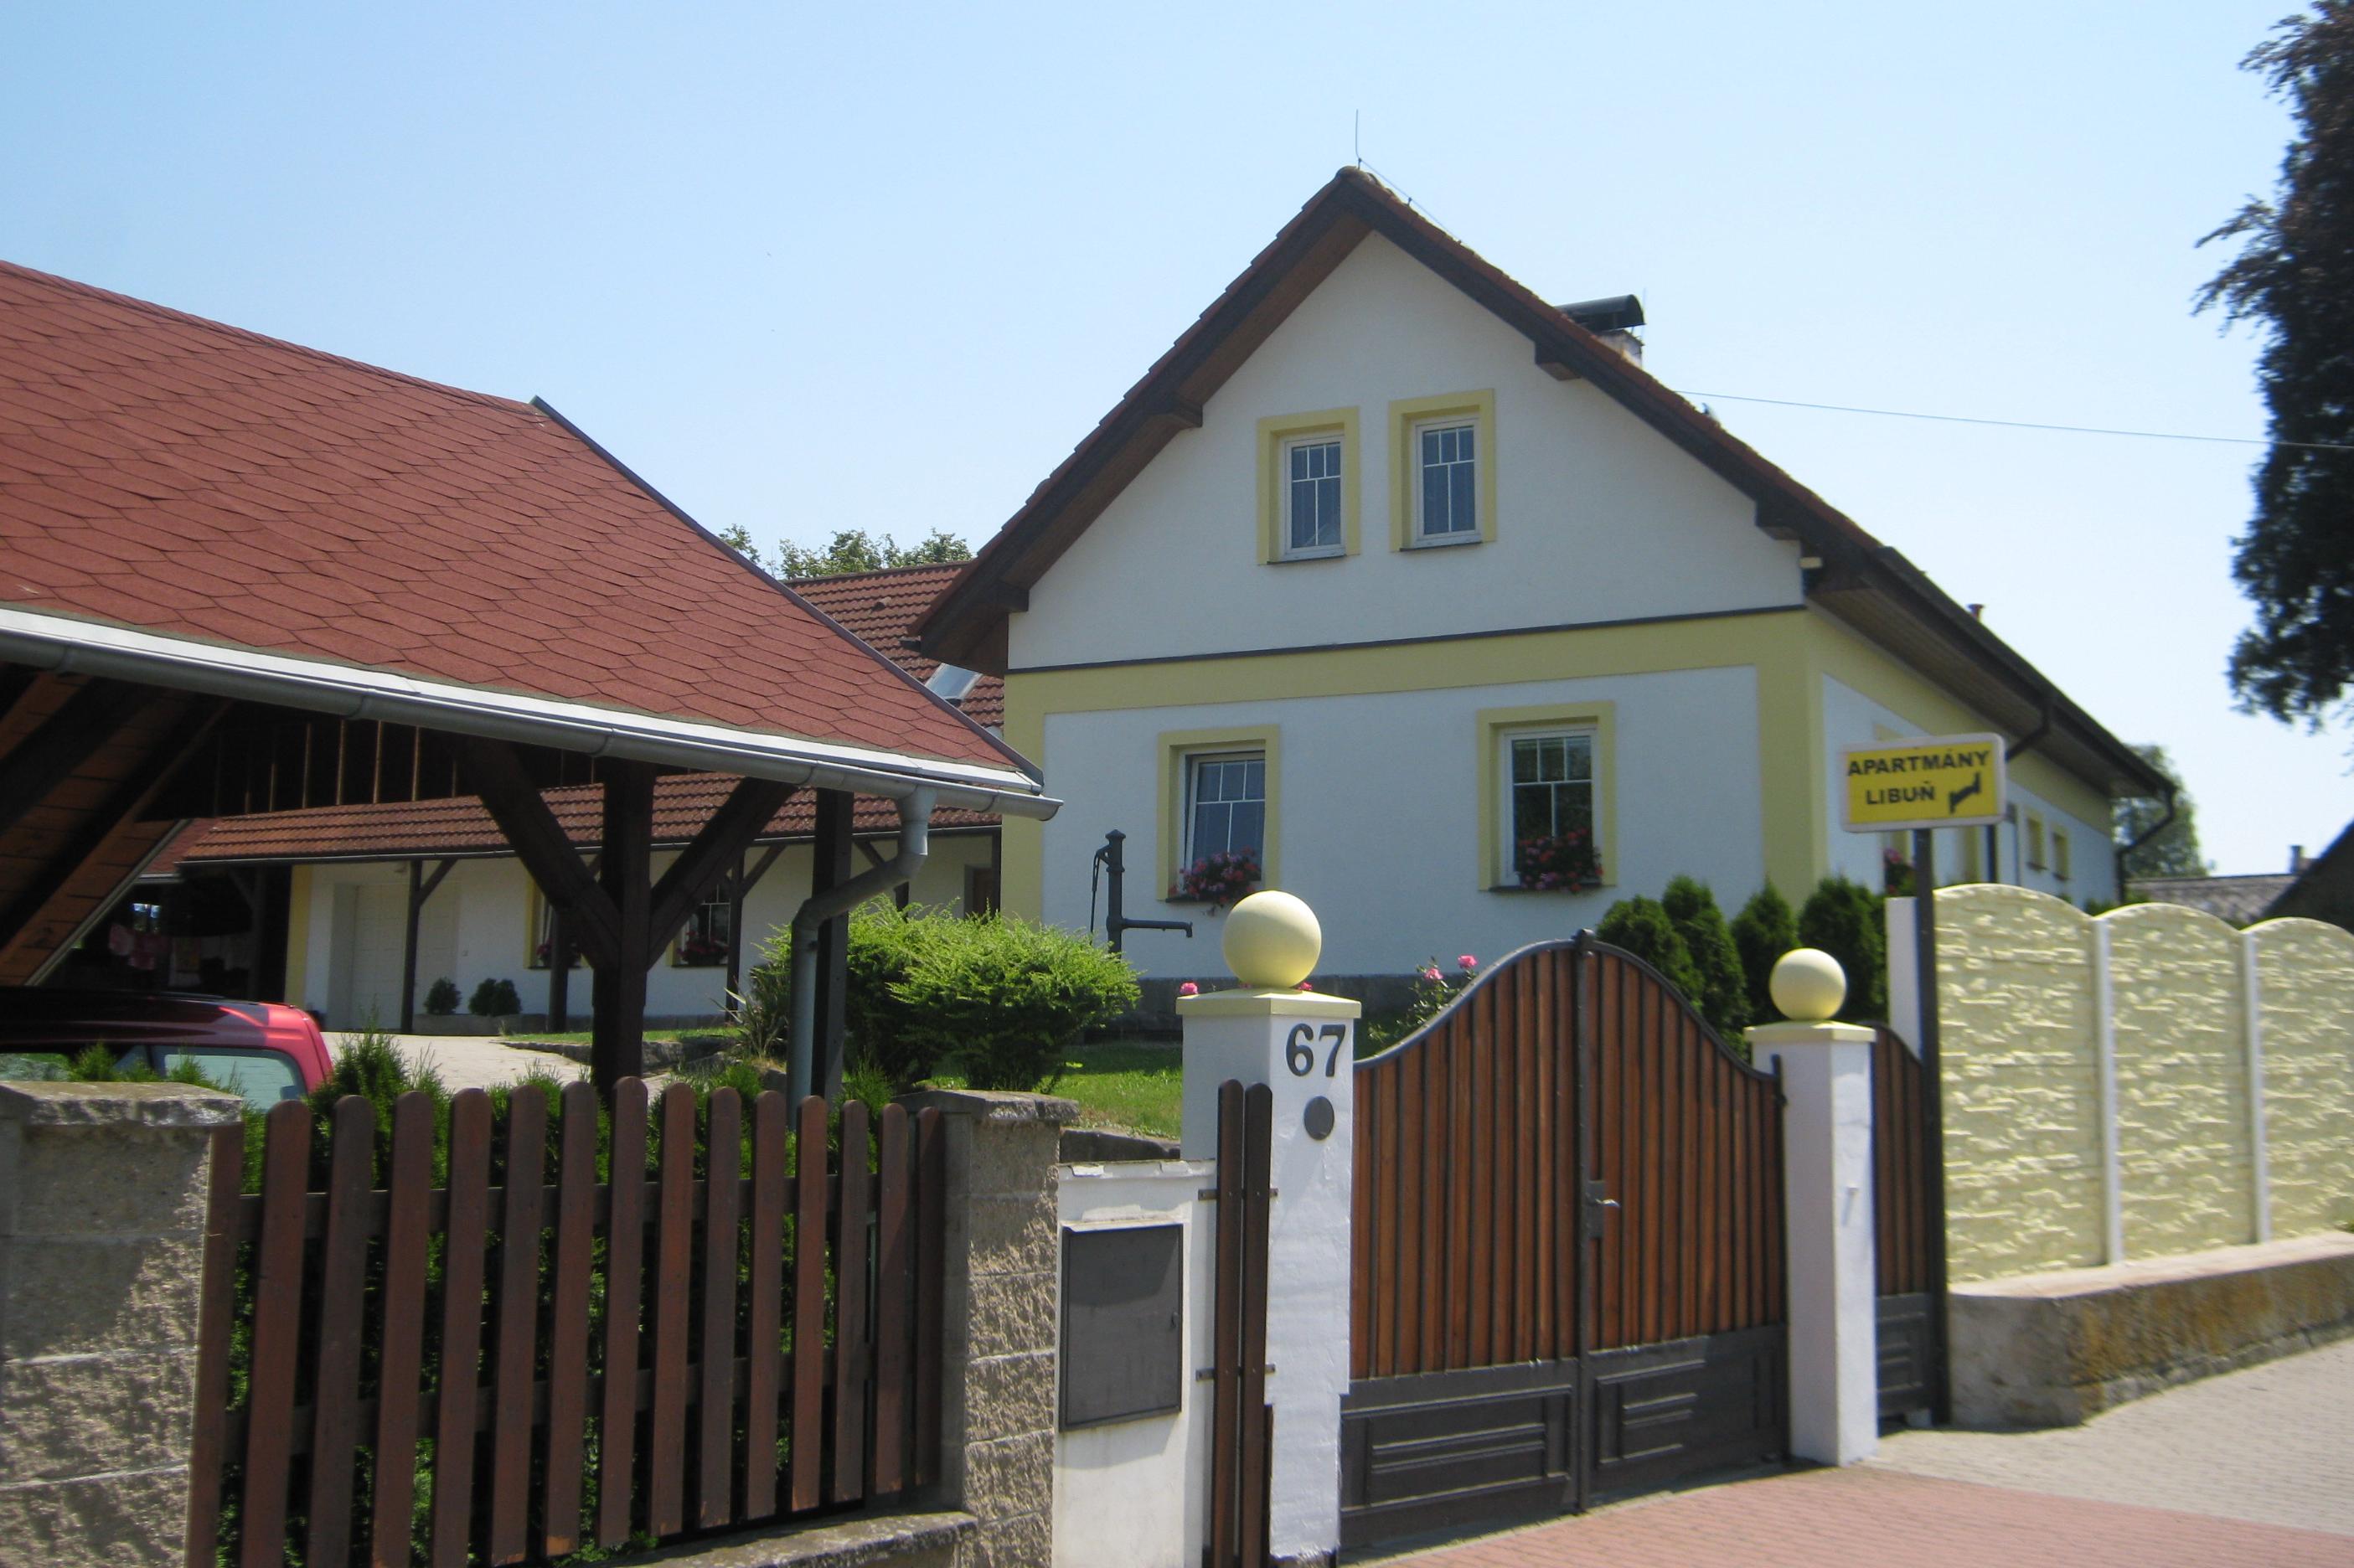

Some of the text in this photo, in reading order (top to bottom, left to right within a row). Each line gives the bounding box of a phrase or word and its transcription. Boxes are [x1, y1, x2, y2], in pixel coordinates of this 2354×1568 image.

[1848, 748, 1990, 776] APARTMÁNY
[1866, 781, 1935, 805] LIBUŇ
[1285, 1023, 1346, 1078] 67
